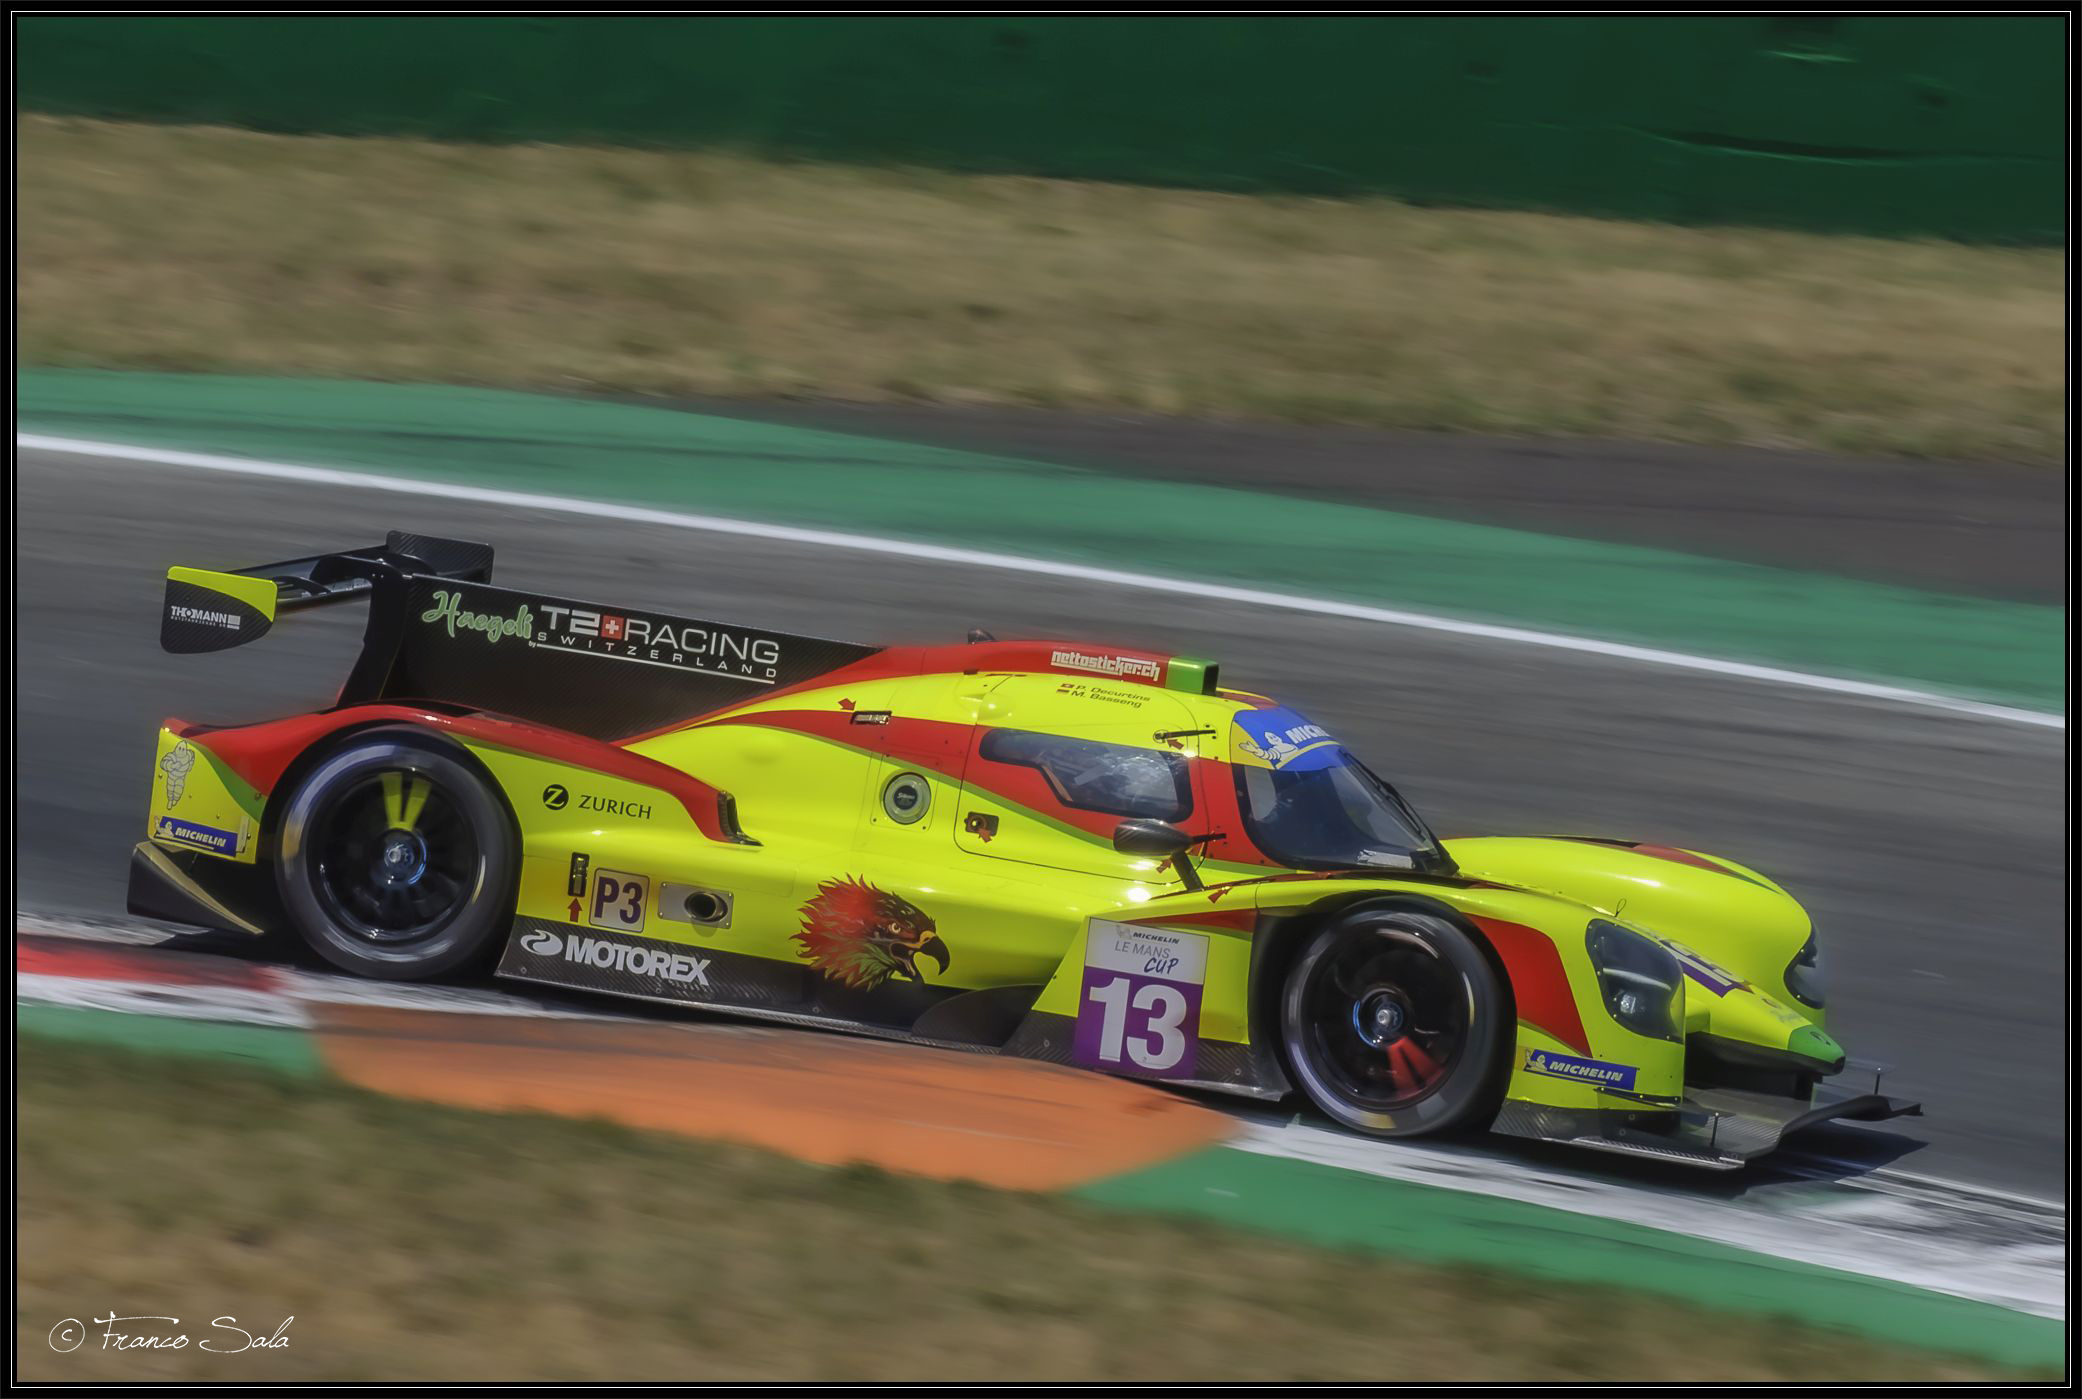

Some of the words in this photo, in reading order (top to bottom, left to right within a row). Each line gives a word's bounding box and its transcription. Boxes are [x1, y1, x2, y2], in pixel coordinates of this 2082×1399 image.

[171, 606, 228, 624] THOMANN
[422, 590, 534, 643] Haegeli
[541, 605, 600, 636] T2
[624, 618, 780, 664] RACING
[537, 632, 777, 678] SWITZERLAND
[1050, 651, 1161, 682] nettosticker.ch
[1090, 693, 1142, 709] Basseng
[578, 794, 652, 819] ZURICH
[175, 827, 227, 847] MICHELIN
[594, 876, 643, 924] P3
[1115, 940, 1131, 953] LE
[1132, 943, 1171, 959] MANS
[1132, 931, 1180, 945] MICHELIN
[564, 935, 711, 986] MOTOREX
[1143, 957, 1180, 975] CUP
[1089, 977, 1187, 1070] 13
[1549, 1061, 1624, 1082] MICHELIN
